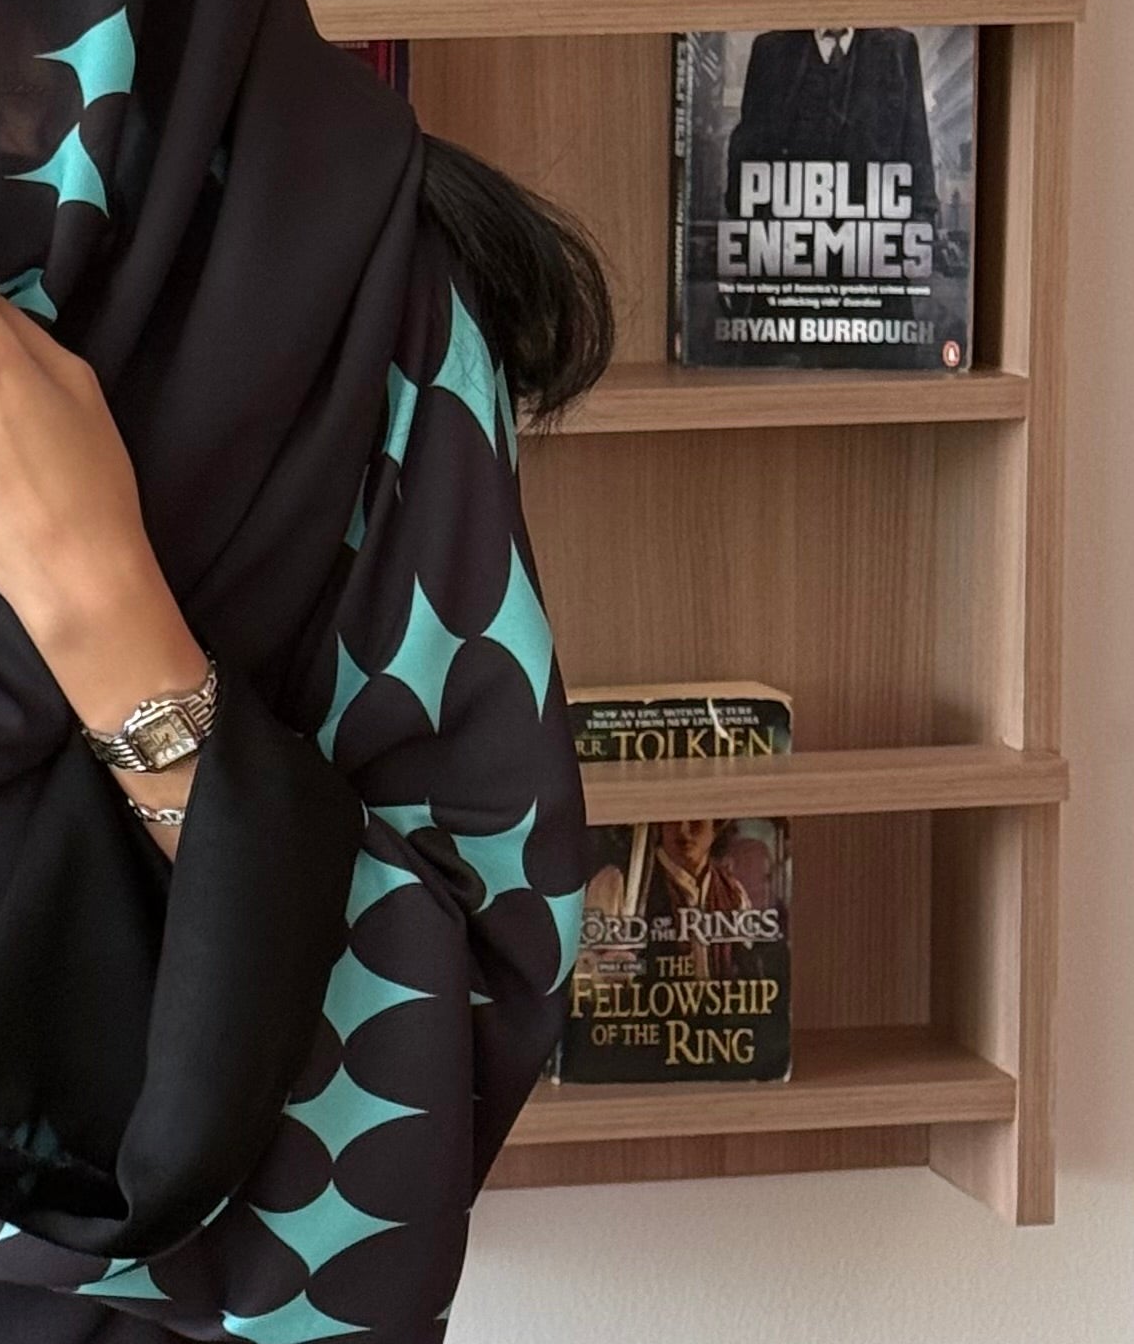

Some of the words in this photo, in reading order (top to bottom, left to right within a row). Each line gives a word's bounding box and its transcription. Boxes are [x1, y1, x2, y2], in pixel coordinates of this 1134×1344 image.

[739, 161, 913, 219] PUBLIC
[716, 221, 934, 279] ENEMIES
[717, 317, 796, 343] BRYAN
[799, 317, 935, 344] BURROUGH
[579, 915, 649, 950] ORD
[650, 928, 677, 943] THE
[653, 916, 673, 928] OF
[657, 956, 696, 978] THE
[570, 973, 779, 1018] FELLOWSHIP
[591, 1024, 619, 1047] OF
[621, 1023, 660, 1045] THE
[665, 1019, 756, 1066] RING
